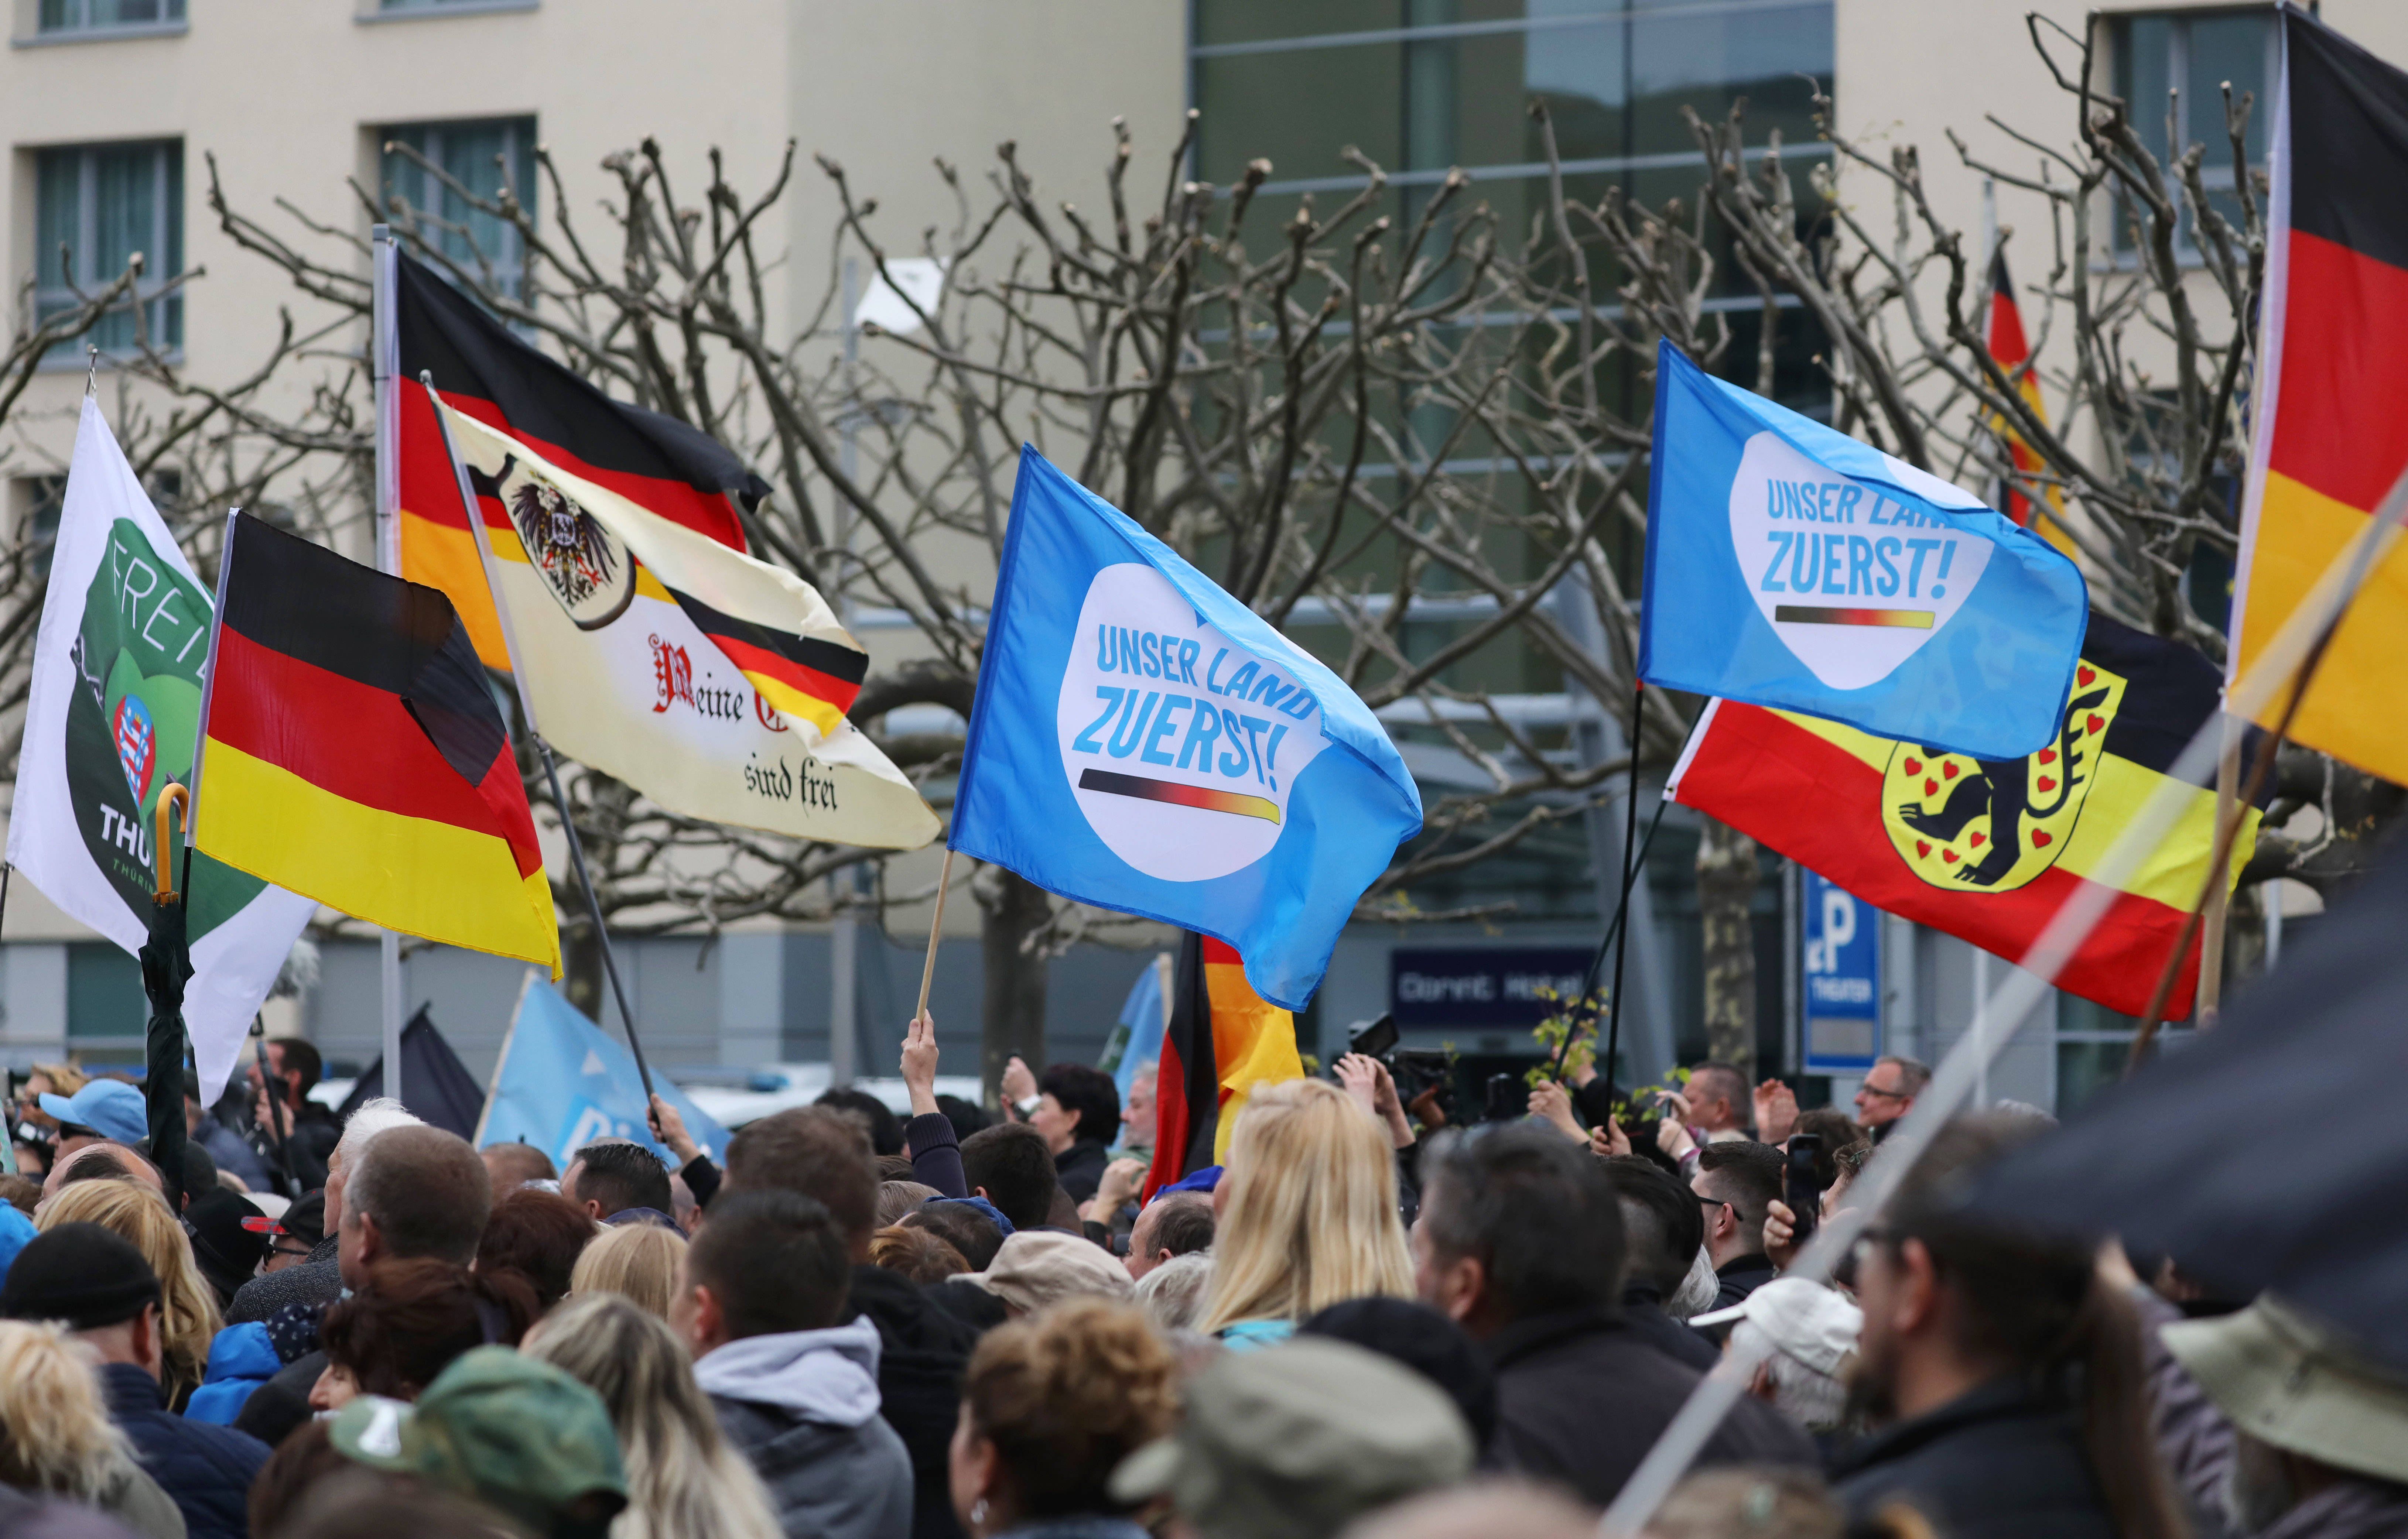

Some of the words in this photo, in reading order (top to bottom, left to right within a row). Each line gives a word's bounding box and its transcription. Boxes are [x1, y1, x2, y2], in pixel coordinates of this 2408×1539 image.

[1767, 479, 1863, 524] UNSER
[1761, 531, 1957, 599] ZUERST!
[113, 538, 208, 679] FREI
[648, 633, 743, 723] Meine
[1097, 624, 1198, 686] UNSER
[1207, 647, 1319, 720] LAND
[1071, 685, 1289, 792] ZUERST!
[744, 752, 792, 801] sind
[799, 755, 838, 819] frei
[113, 857, 154, 895] THÜRIN
